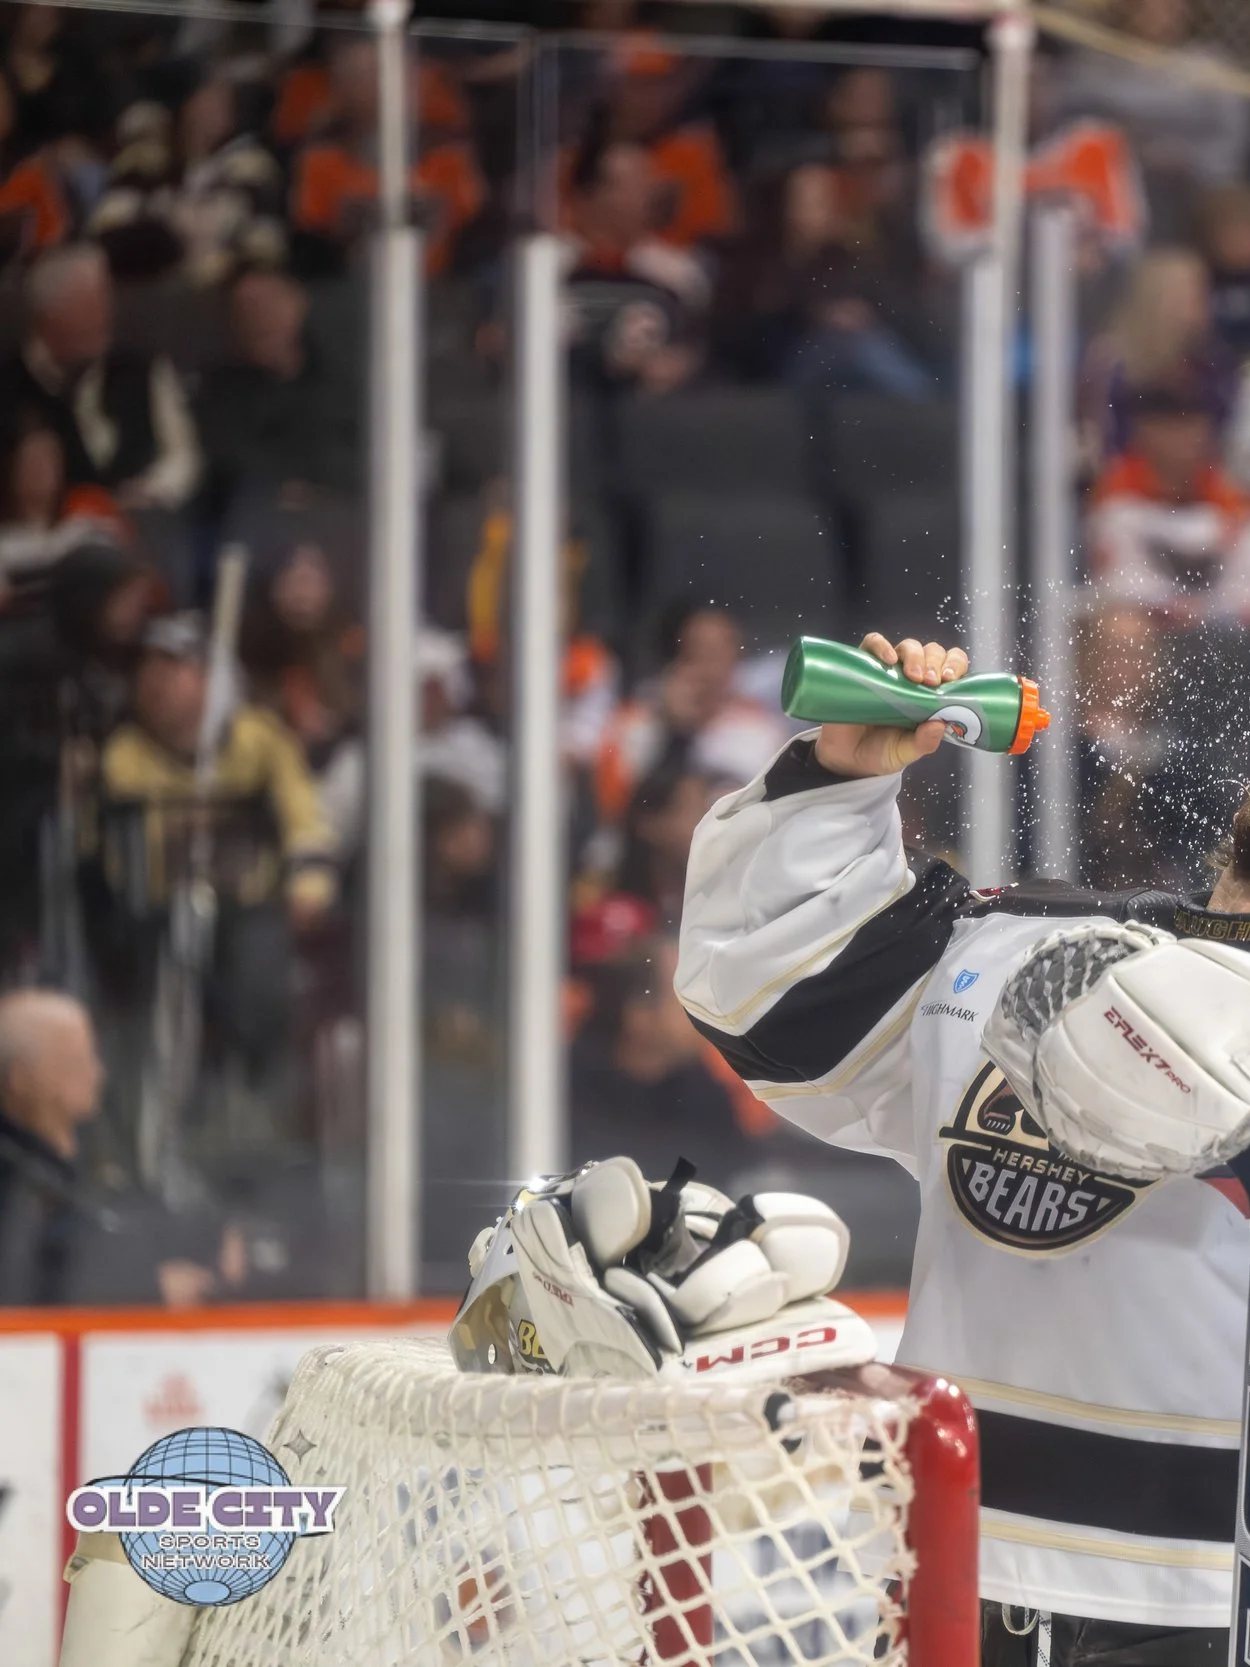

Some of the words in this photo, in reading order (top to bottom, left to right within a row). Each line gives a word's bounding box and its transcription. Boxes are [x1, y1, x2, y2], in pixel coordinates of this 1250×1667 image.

[993, 1149, 1091, 1186] HERSHEY
[968, 1161, 1097, 1232] BEARS
[696, 1327, 837, 1373] CCM
